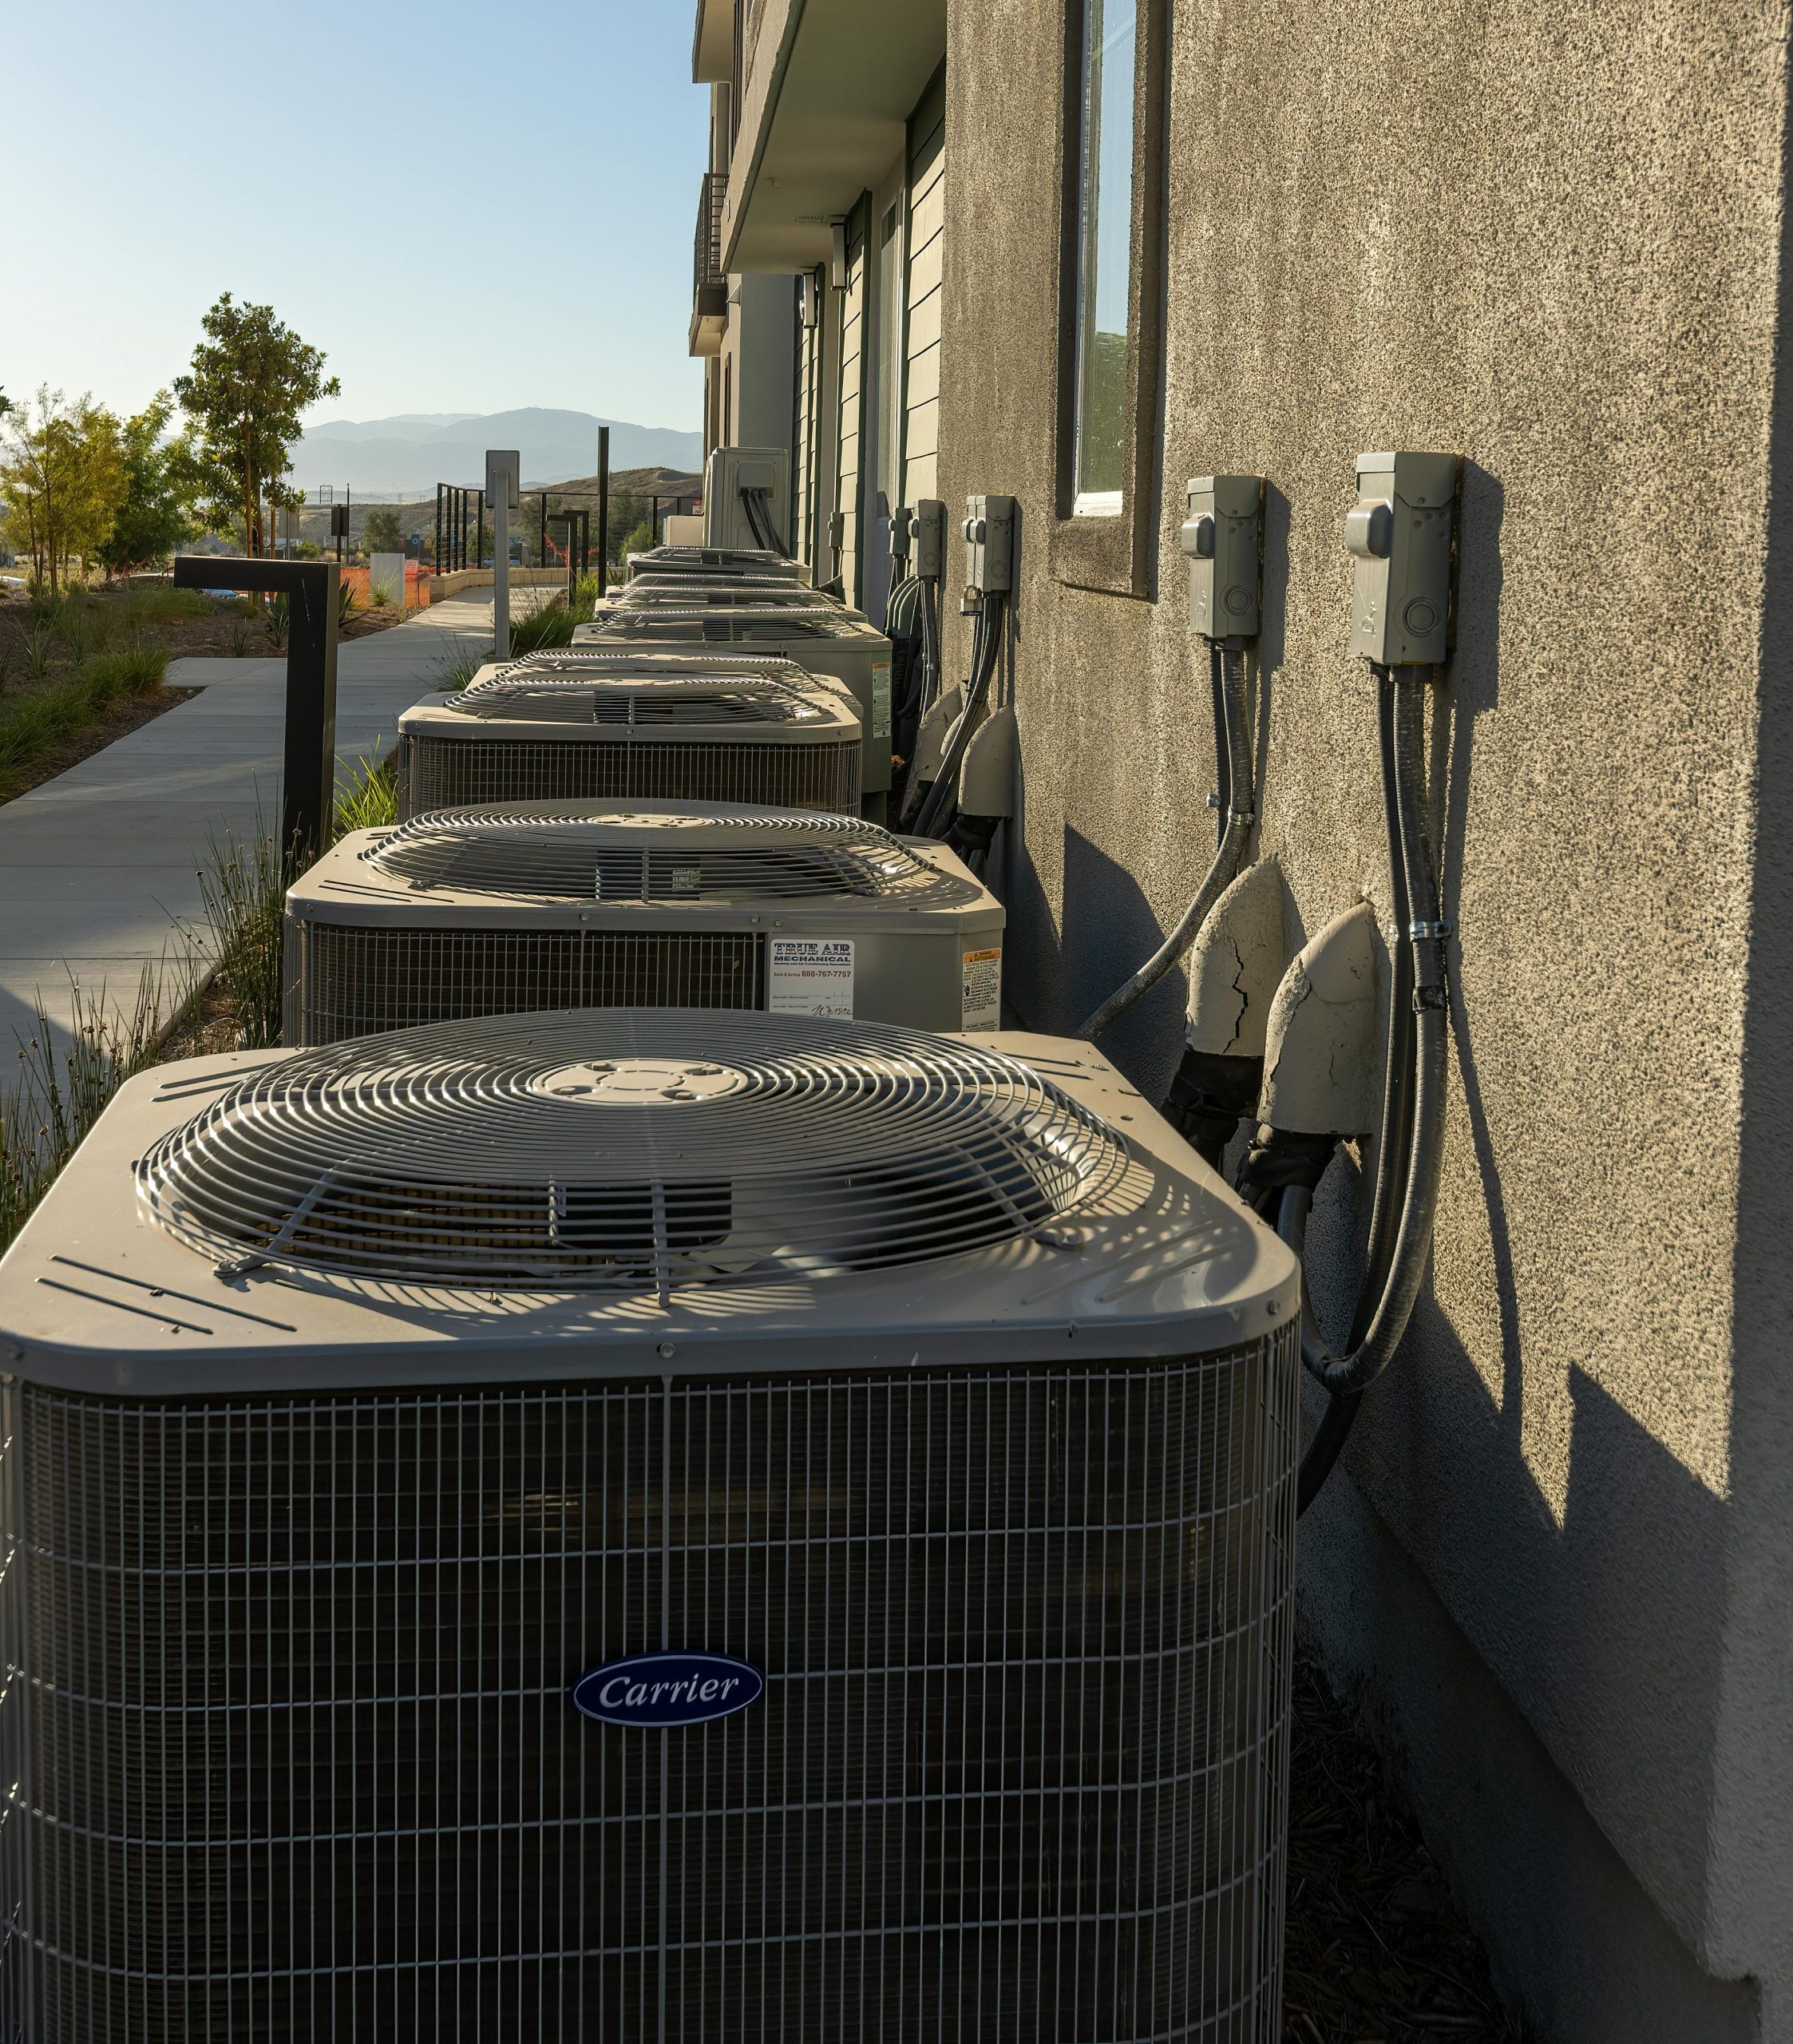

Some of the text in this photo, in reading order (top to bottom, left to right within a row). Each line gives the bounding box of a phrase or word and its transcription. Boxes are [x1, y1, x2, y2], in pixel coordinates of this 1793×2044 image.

[774, 943, 851, 956] TRUE AIR
[599, 1673, 739, 1709] Carrier
